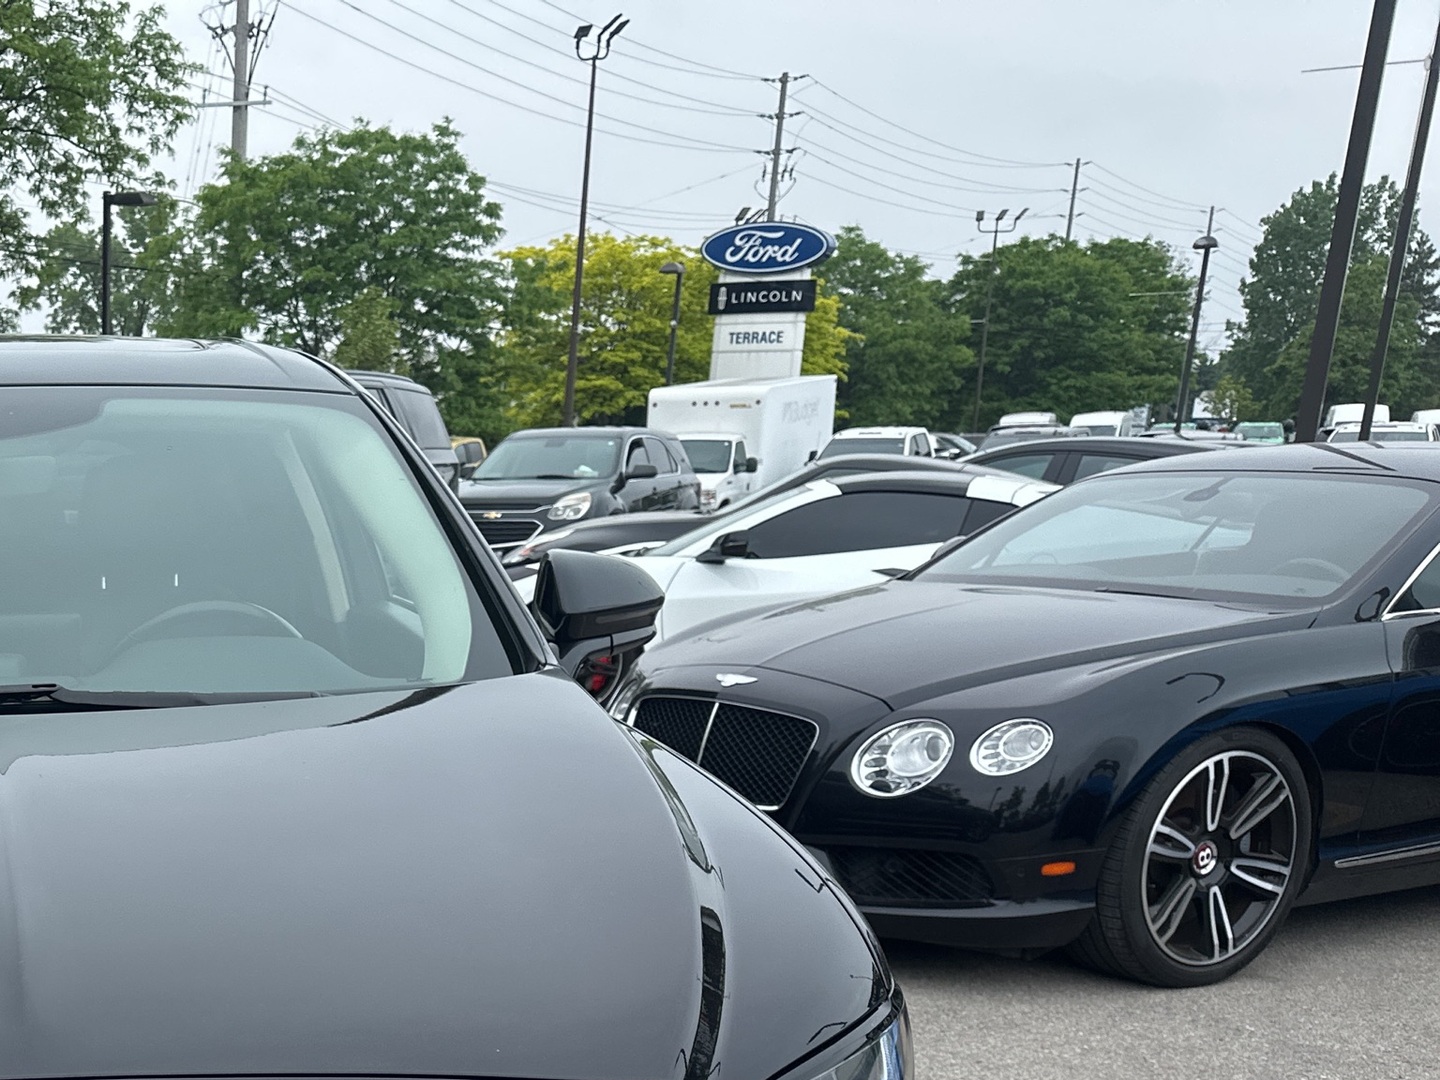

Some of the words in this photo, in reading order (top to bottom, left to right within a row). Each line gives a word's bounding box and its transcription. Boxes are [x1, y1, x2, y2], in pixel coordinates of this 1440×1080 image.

[724, 230, 803, 263] Ford
[730, 290, 803, 304] LINCOLN
[728, 331, 784, 345] TERRACE
